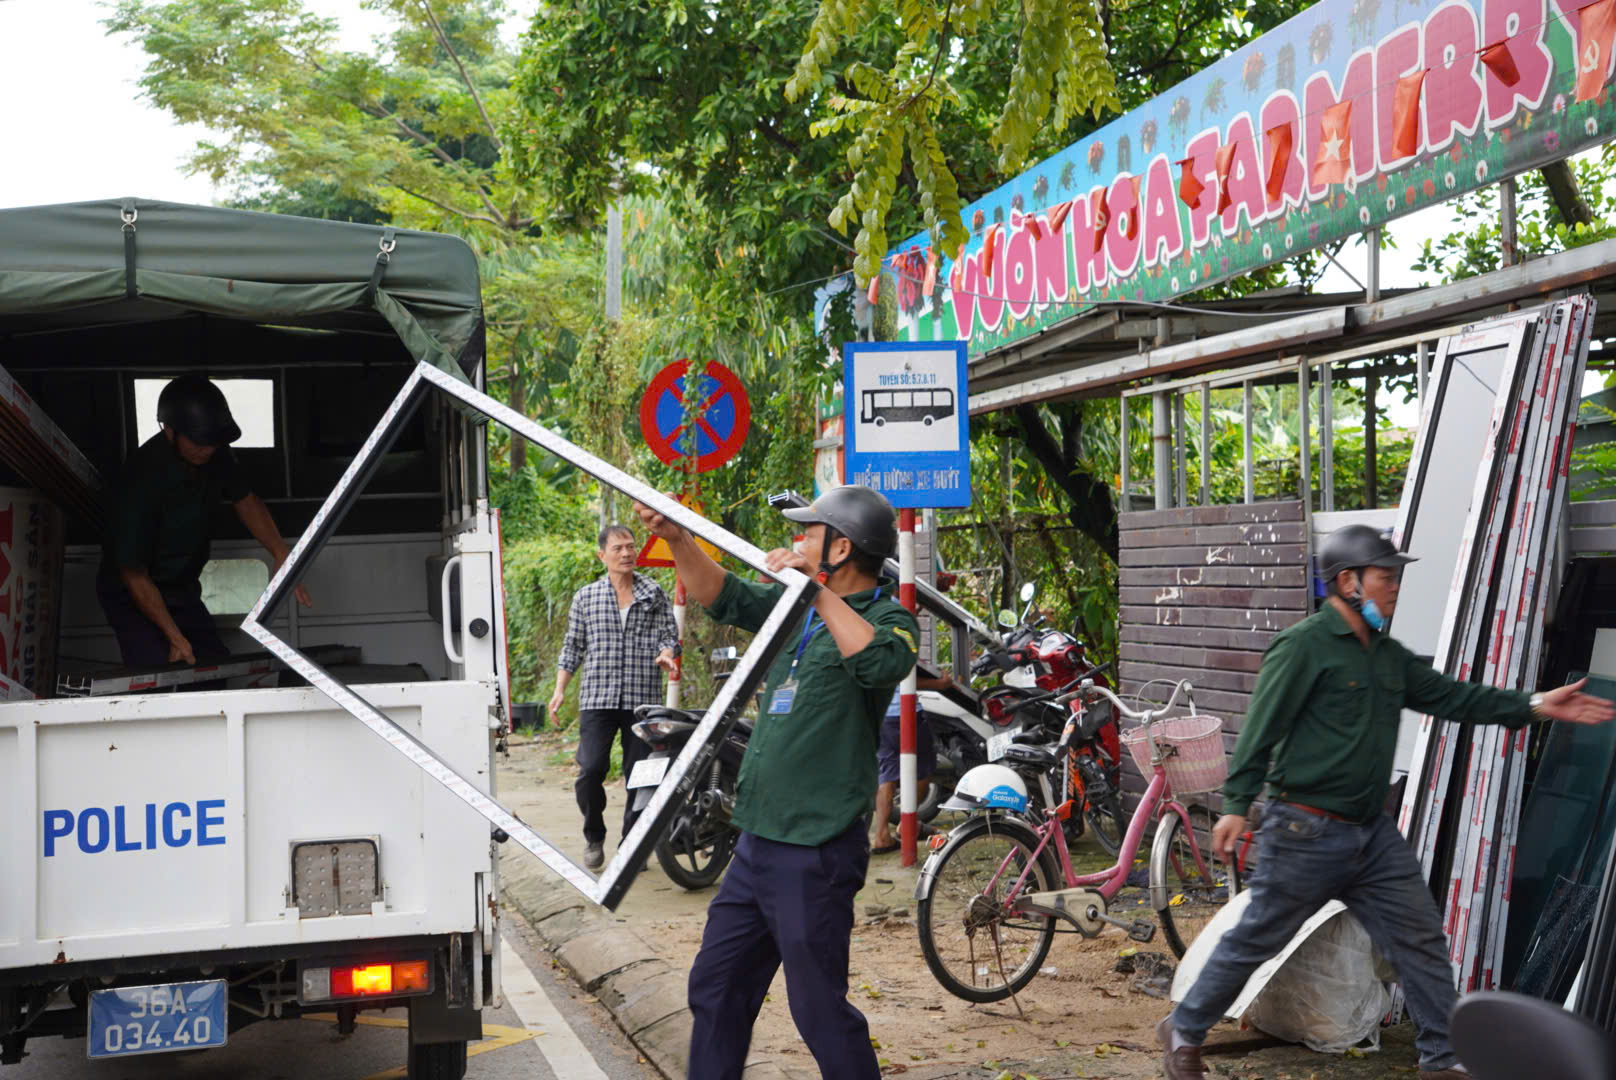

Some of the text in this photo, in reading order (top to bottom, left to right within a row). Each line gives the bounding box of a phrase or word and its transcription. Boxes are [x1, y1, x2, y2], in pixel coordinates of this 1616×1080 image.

[1071, 153, 1184, 294] HOA
[43, 798, 226, 858] POLICE
[130, 987, 187, 1019] 36A
[104, 1015, 211, 1052] 034.40
